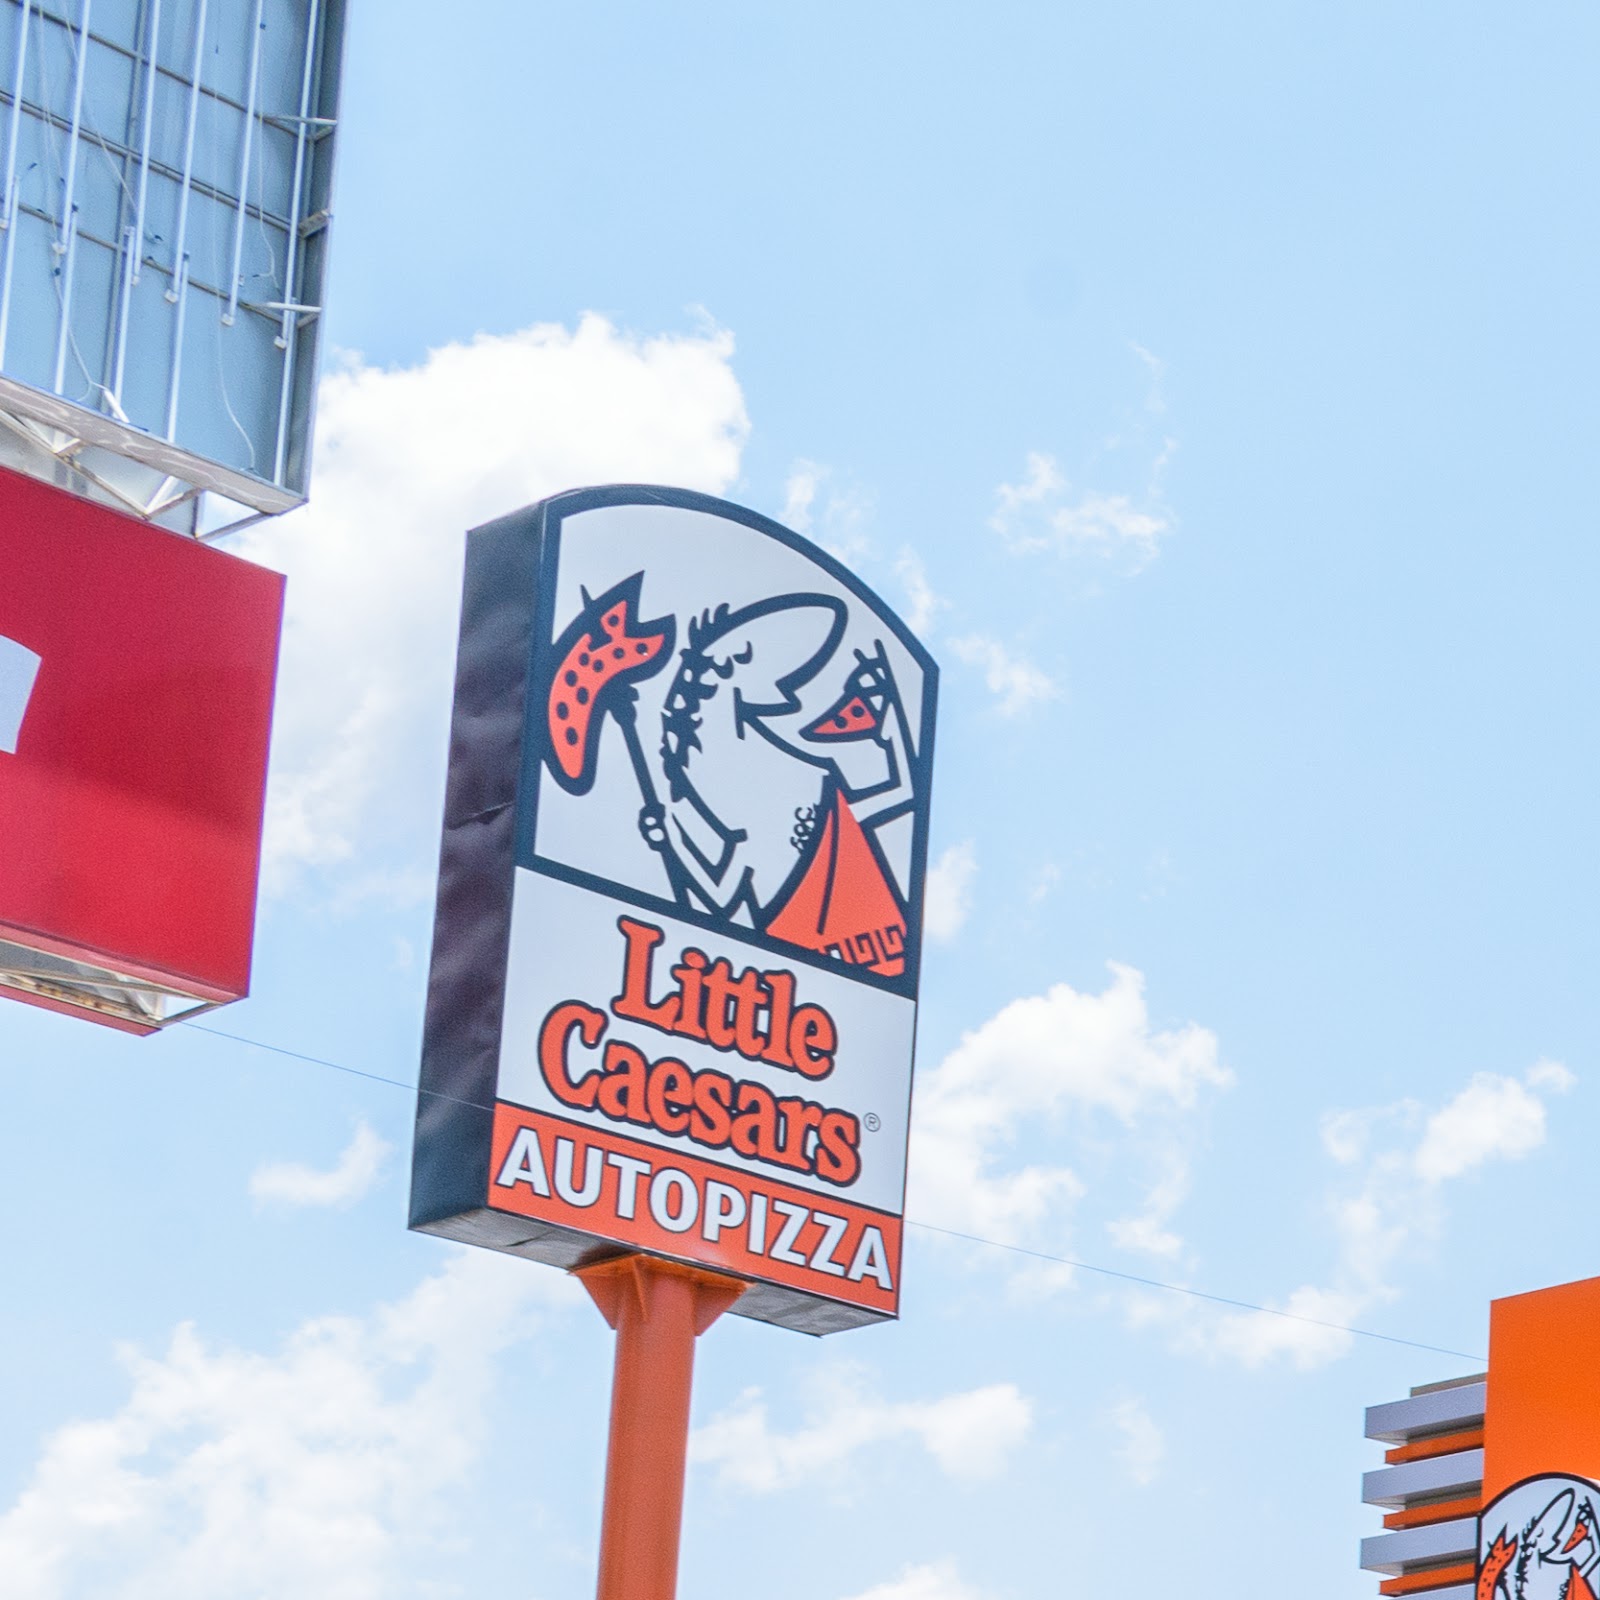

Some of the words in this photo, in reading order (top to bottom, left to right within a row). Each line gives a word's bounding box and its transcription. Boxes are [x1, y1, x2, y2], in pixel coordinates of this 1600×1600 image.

[610, 914, 838, 1082] Little
[537, 1000, 864, 1188] Caesars
[495, 1126, 895, 1293] AUTOPIZZA
